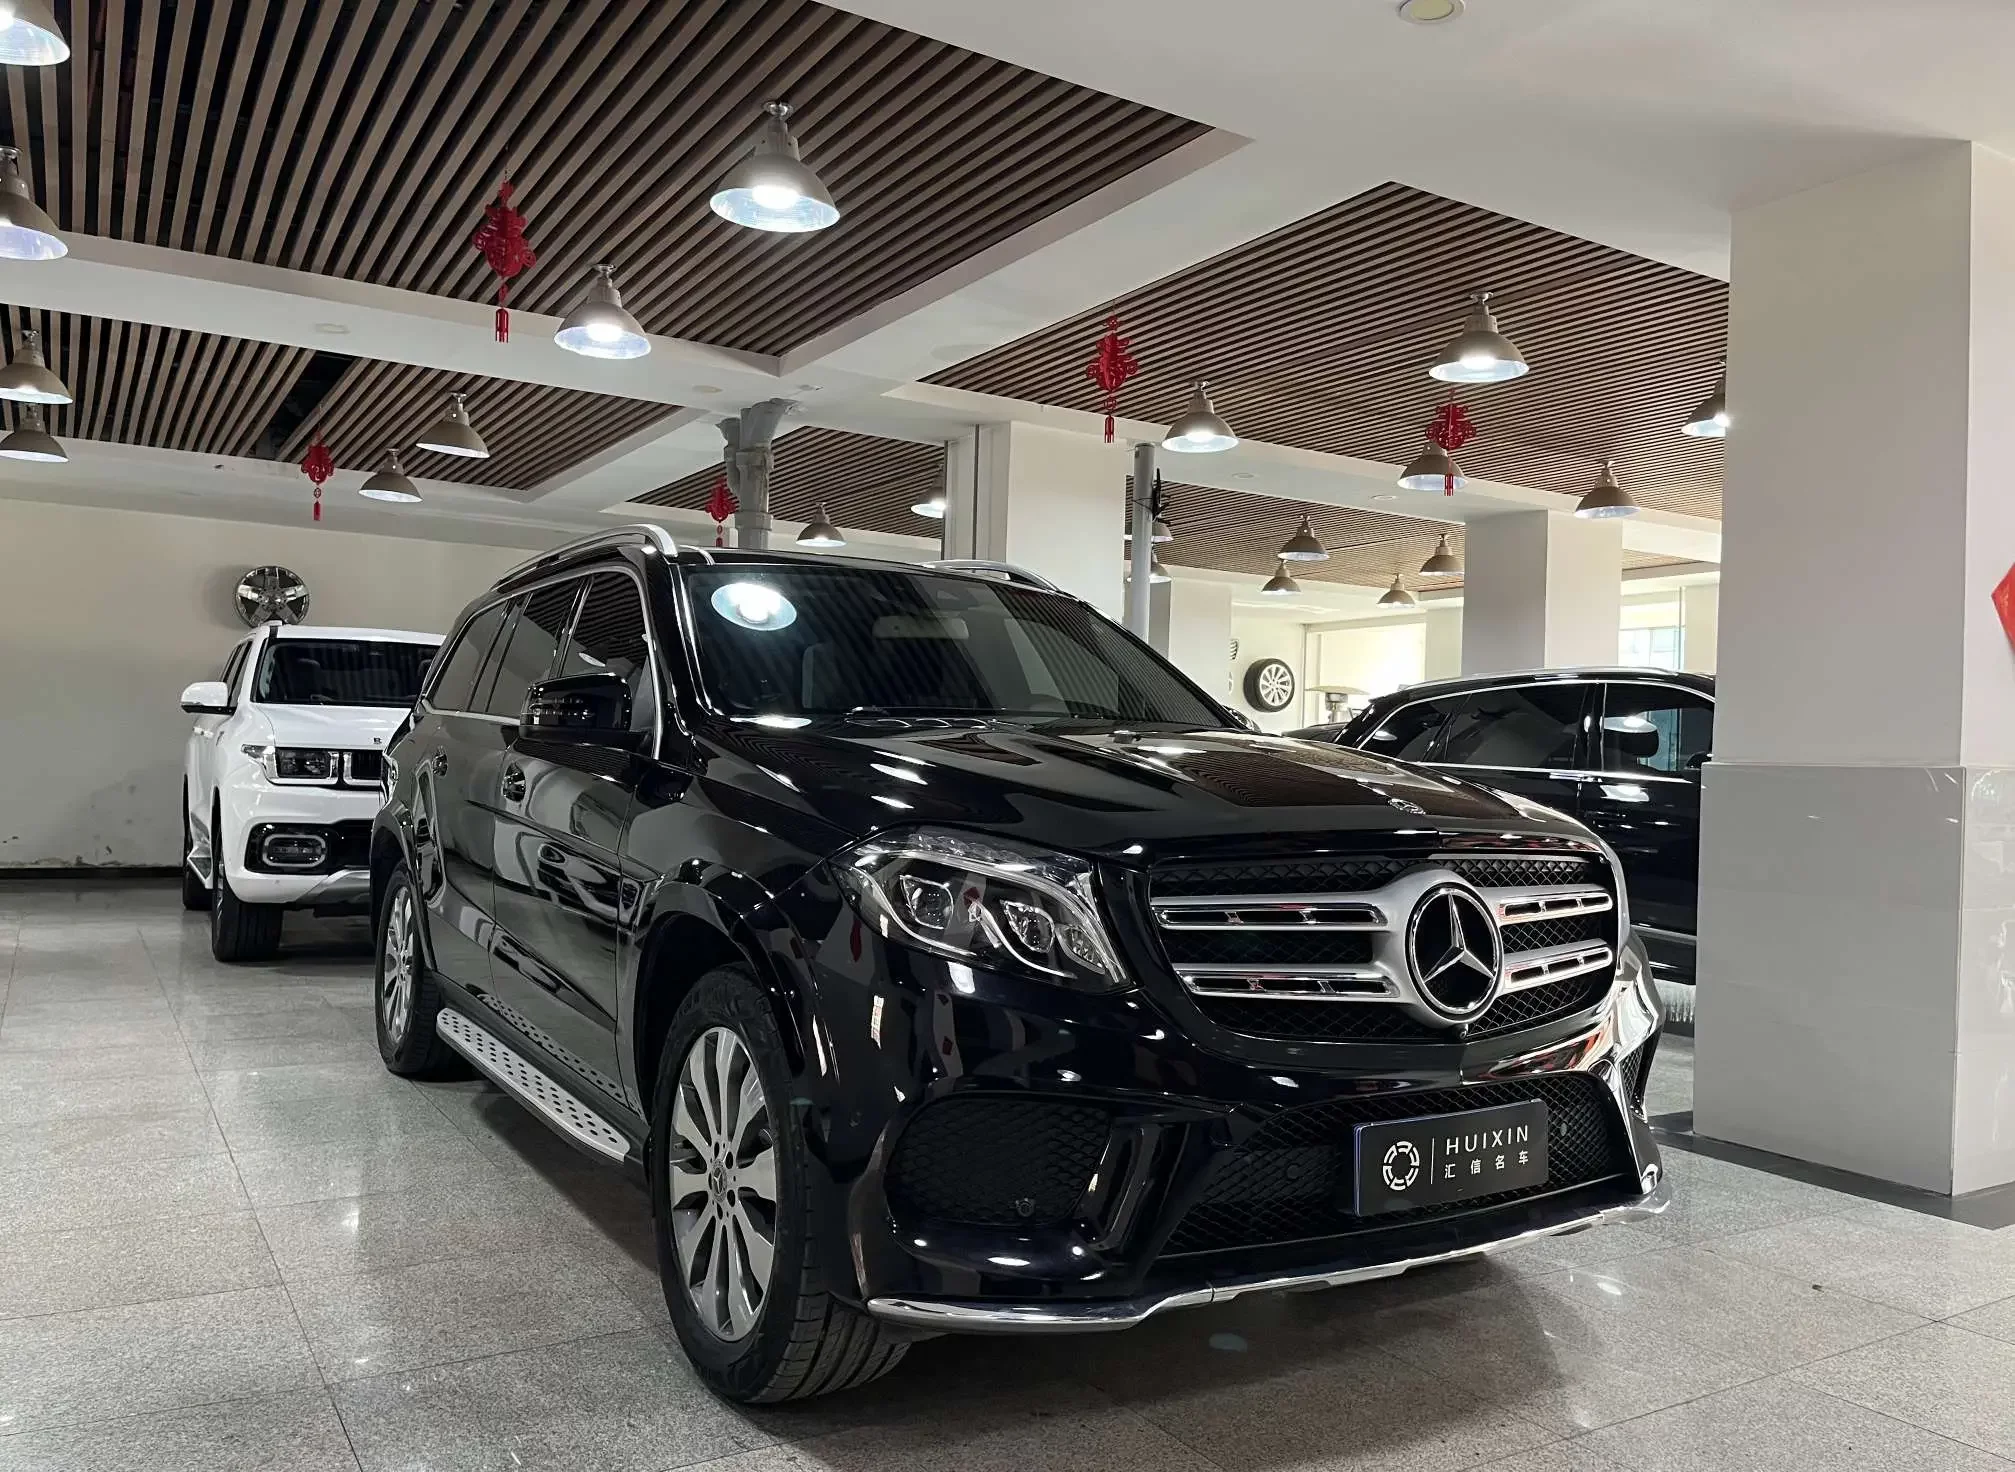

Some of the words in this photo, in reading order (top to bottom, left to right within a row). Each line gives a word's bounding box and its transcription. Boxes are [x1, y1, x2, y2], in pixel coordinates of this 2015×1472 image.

[1446, 1125, 1528, 1155] HUIXIN
[1444, 1150, 1528, 1179] 汇信名车
